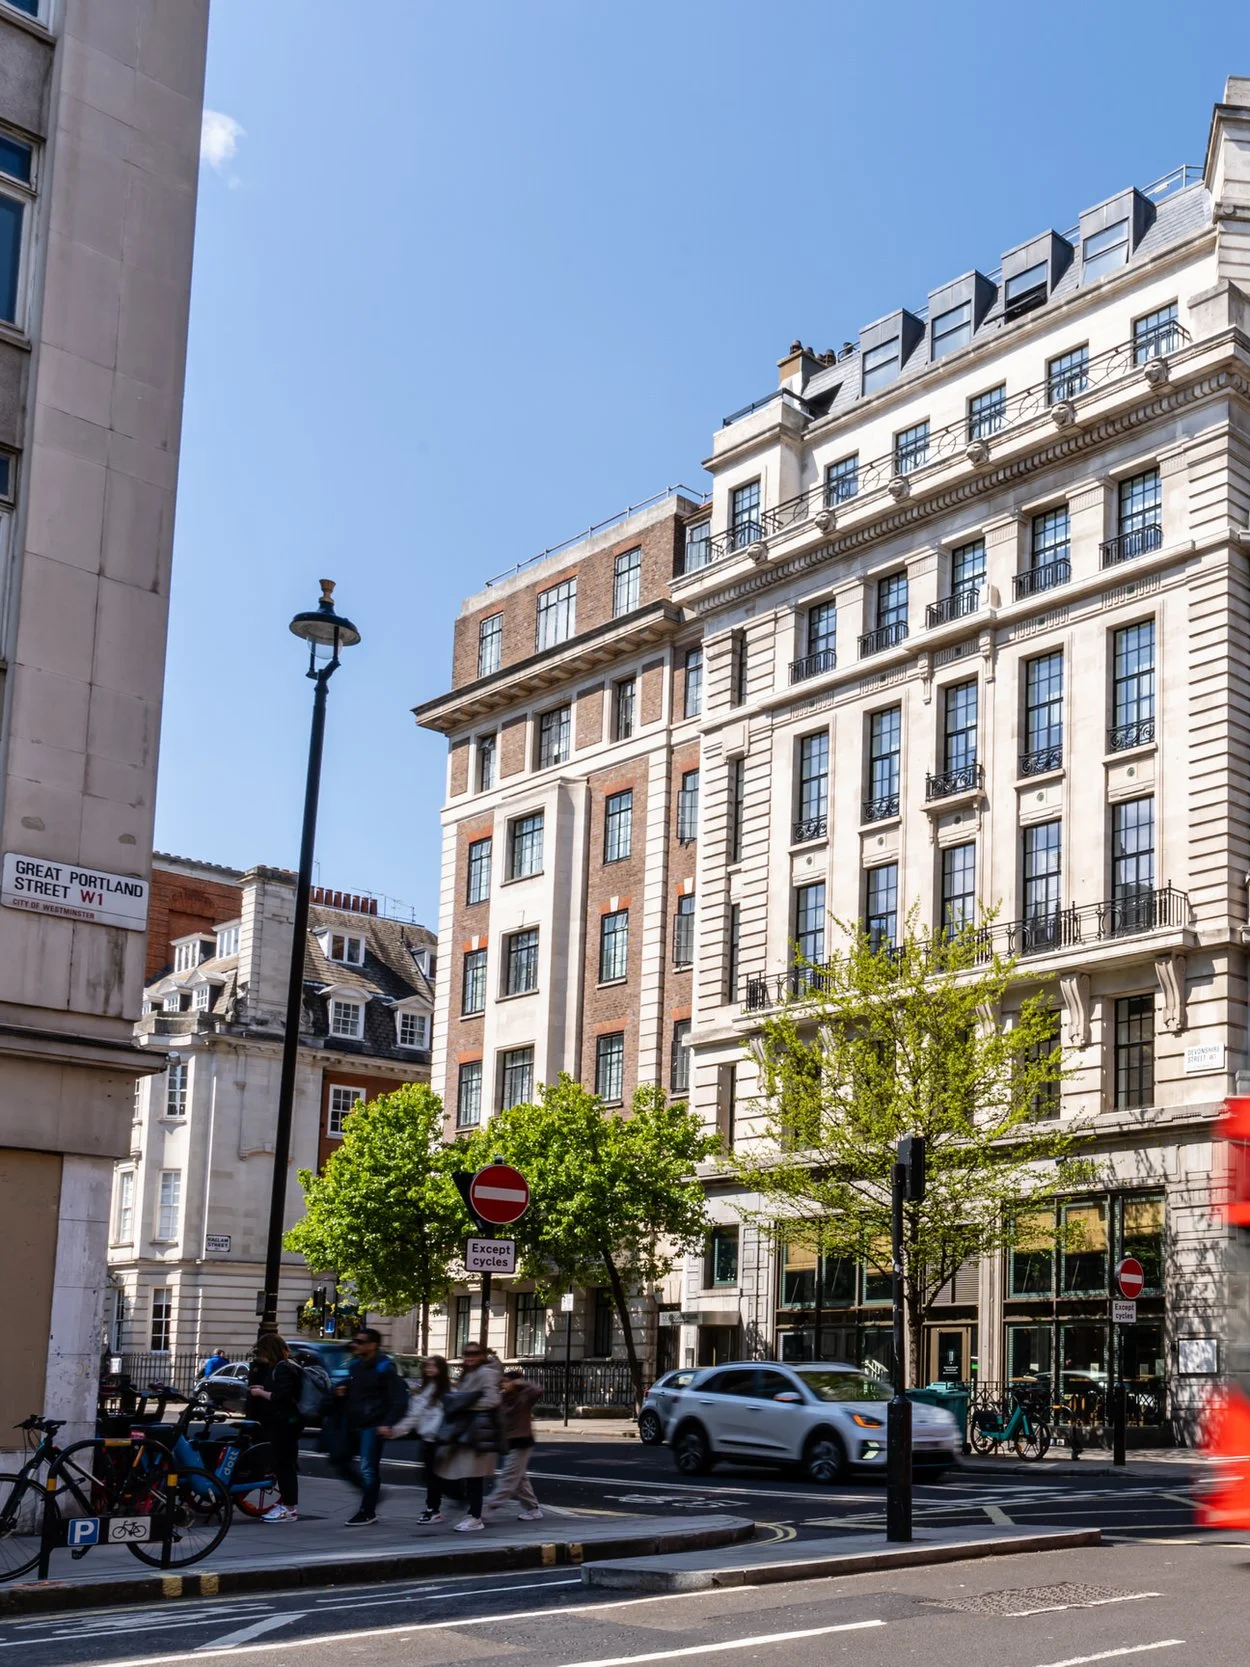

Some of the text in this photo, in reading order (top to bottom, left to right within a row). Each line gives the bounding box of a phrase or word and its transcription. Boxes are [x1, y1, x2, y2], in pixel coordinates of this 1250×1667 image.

[15, 860, 143, 898] GREAT PORTLAND
[14, 876, 103, 906] STREET W1
[12, 898, 94, 919] CITY OF WESTMINSTER
[1188, 1046, 1220, 1056] DEVONSHIRE
[472, 1243, 511, 1256] Except
[472, 1257, 508, 1267] cycles
[223, 1450, 240, 1476] dott
[73, 1520, 95, 1544] P
